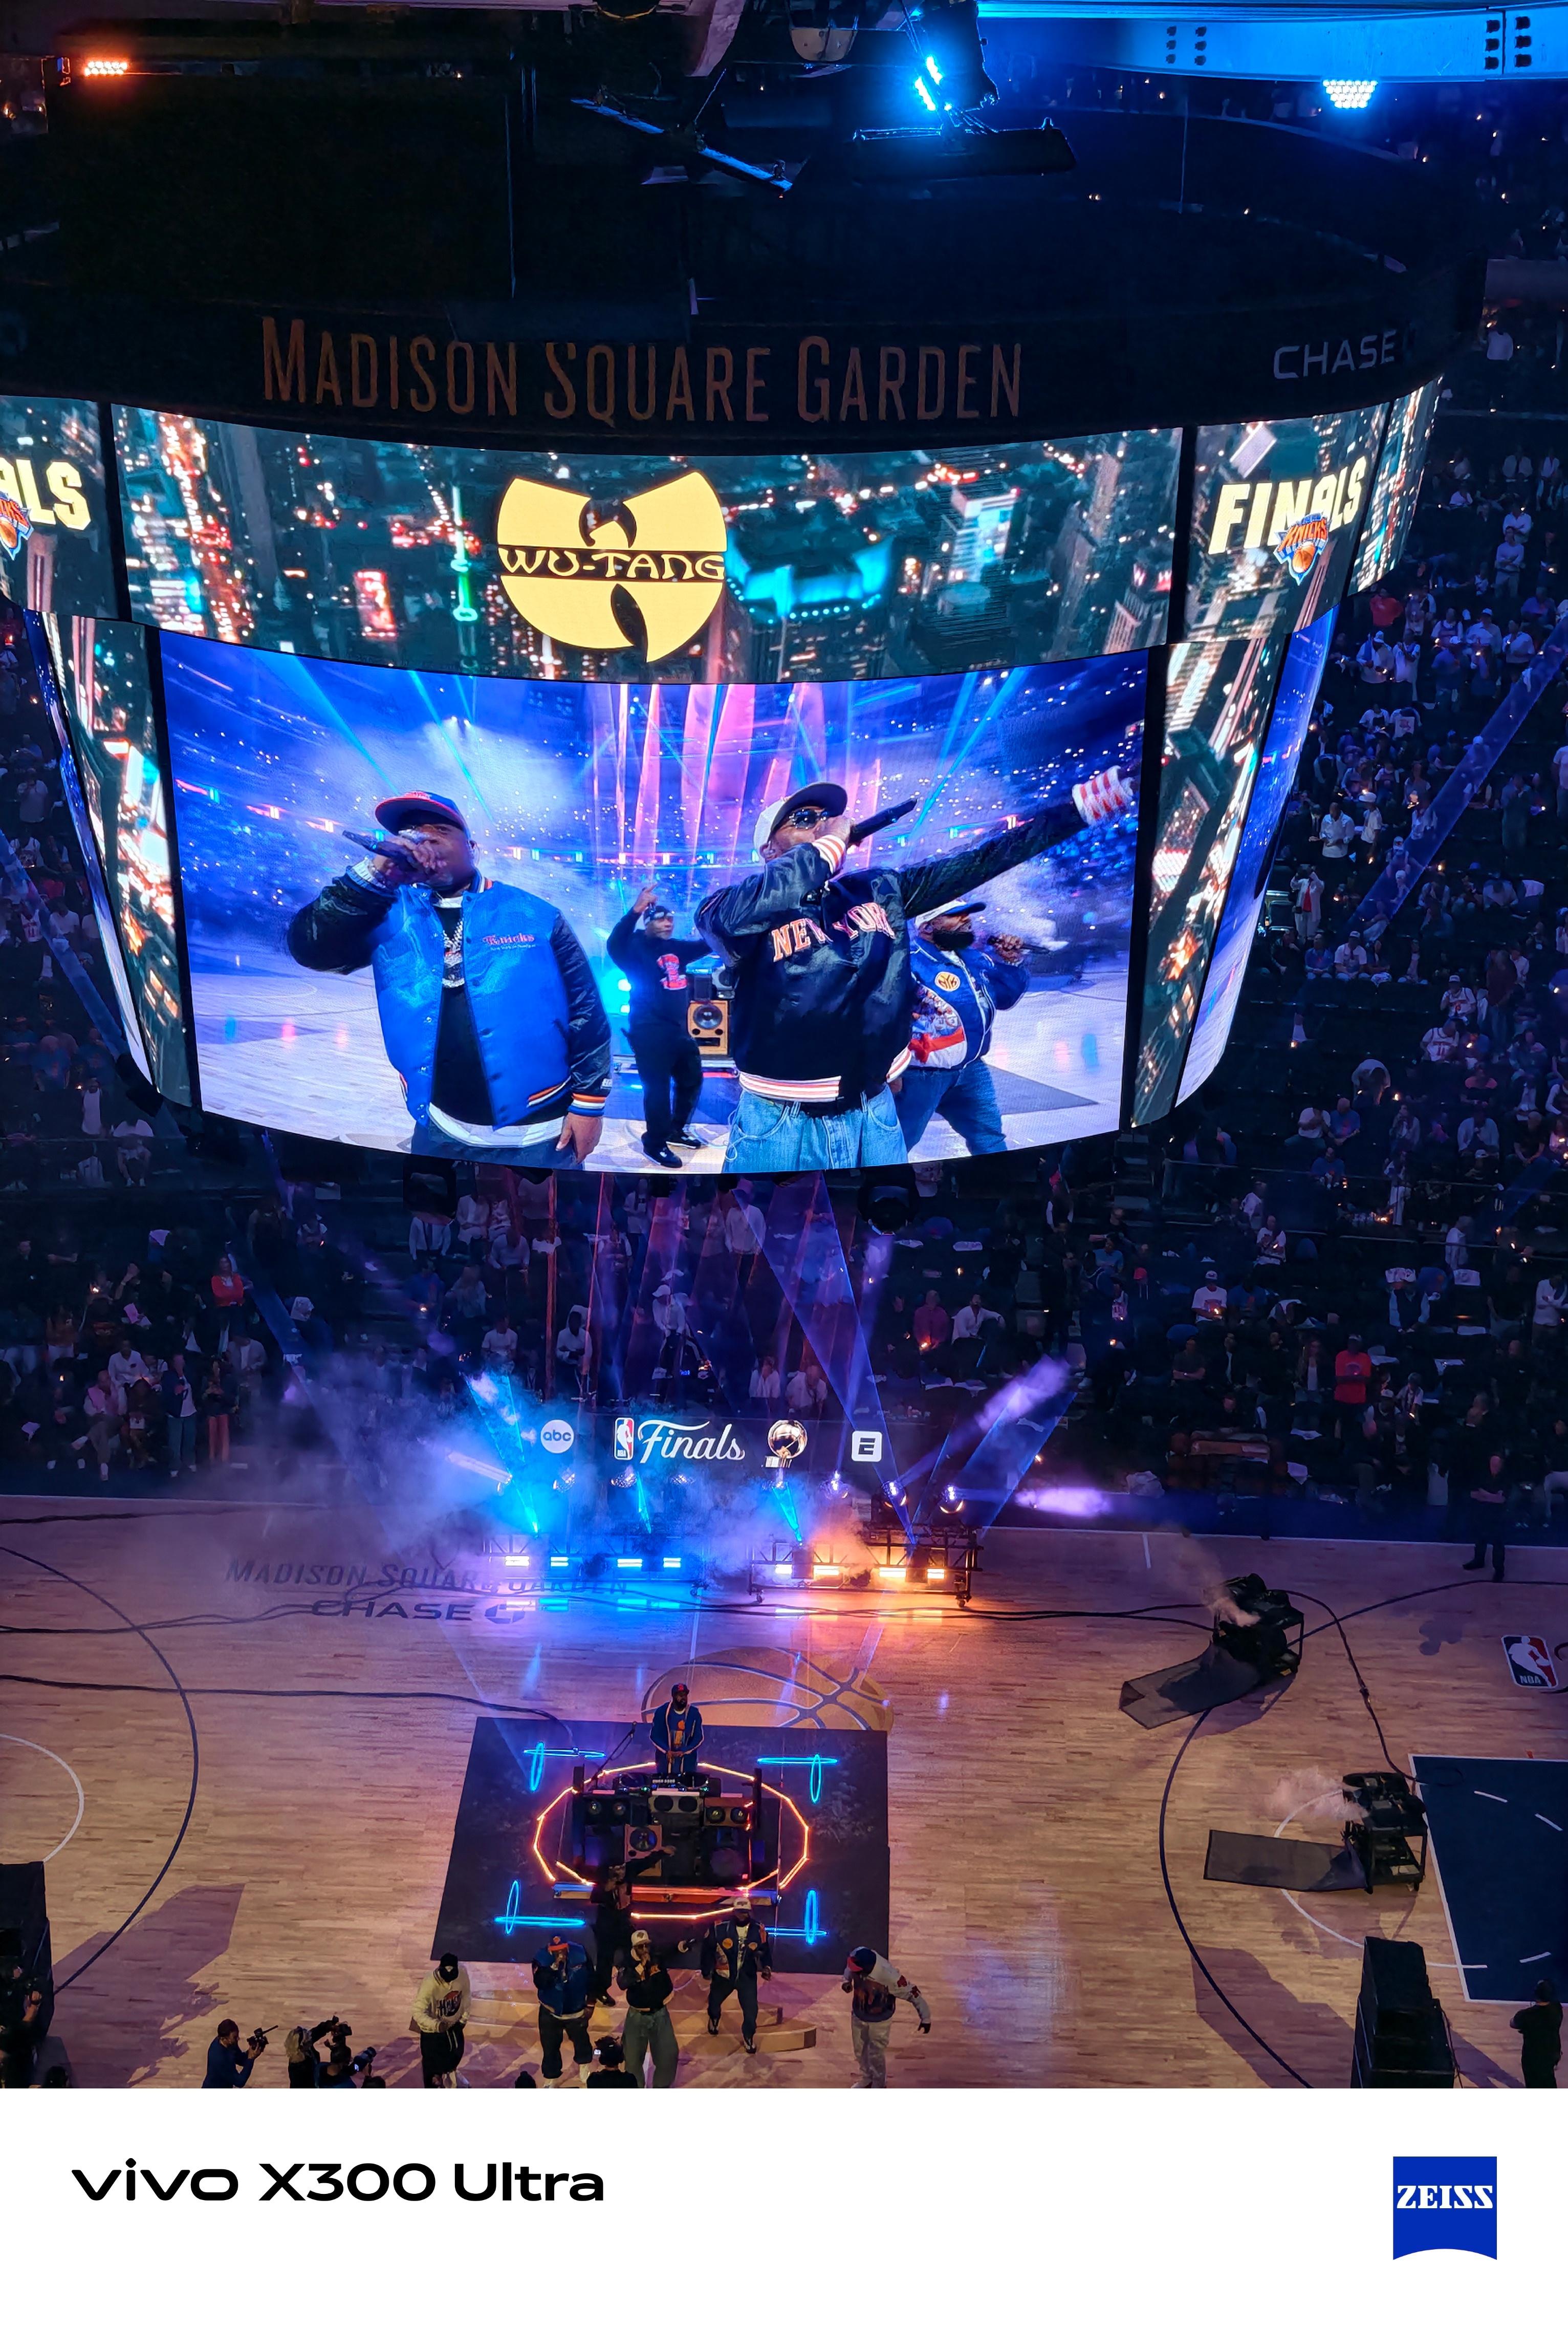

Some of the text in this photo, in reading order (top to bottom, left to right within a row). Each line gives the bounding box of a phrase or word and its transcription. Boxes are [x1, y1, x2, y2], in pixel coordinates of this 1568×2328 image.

[263, 315, 1021, 428] MADISON SQUARE GARDEN
[1274, 329, 1397, 380] CHASE
[1208, 456, 1367, 555] FINALS
[1277, 516, 1327, 552] KNICKS
[498, 547, 725, 580] WU-TANG
[543, 1429, 572, 1441] abc
[638, 1419, 745, 1463] Finals
[226, 1558, 367, 1586] MADISON
[312, 1600, 475, 1621] CHASE
